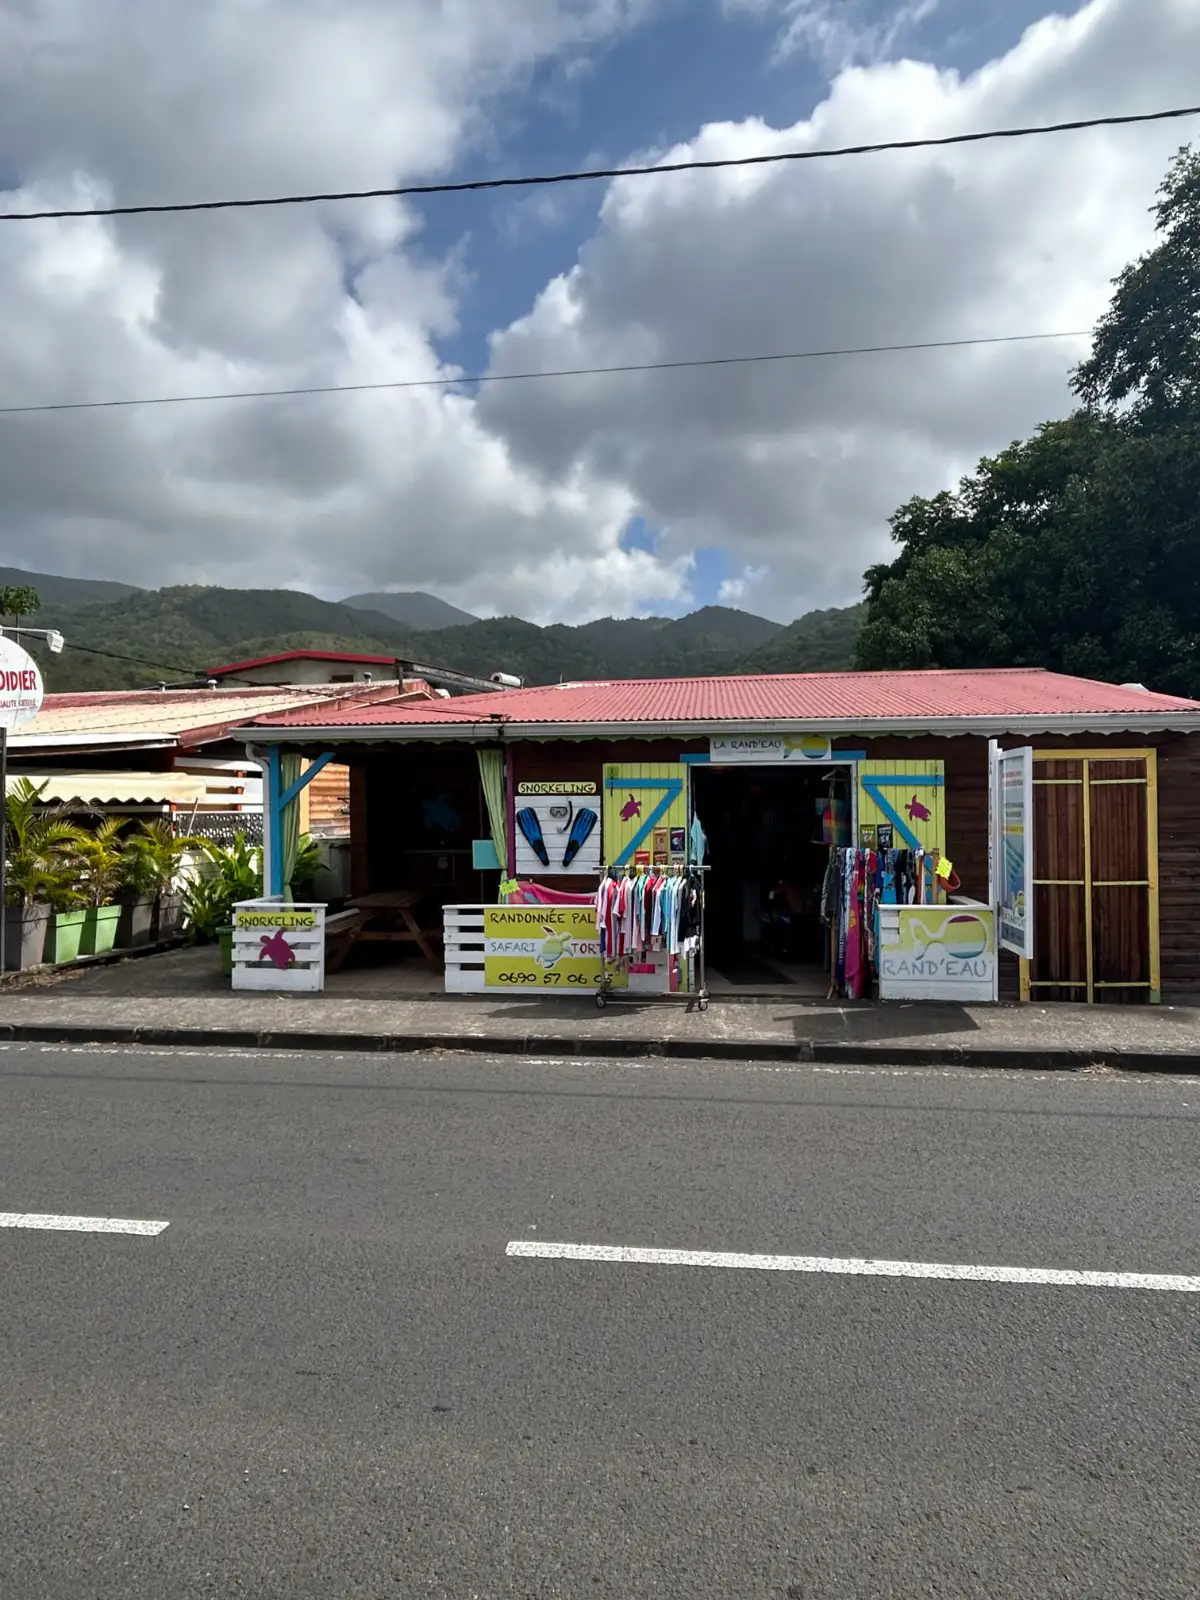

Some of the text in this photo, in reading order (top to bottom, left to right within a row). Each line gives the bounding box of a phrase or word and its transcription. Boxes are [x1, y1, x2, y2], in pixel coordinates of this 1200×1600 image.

[713, 739, 781, 750] LA RAND'EAU
[520, 783, 595, 794] SNORKELING
[238, 916, 315, 927] SNORKELING
[490, 908, 596, 924] RANDONNÉE PAL
[491, 942, 536, 952] SAFARI
[882, 958, 987, 978] RAND'EAU
[498, 972, 537, 984] 0690
[543, 972, 561, 985] 57
[567, 973, 588, 985] 06
